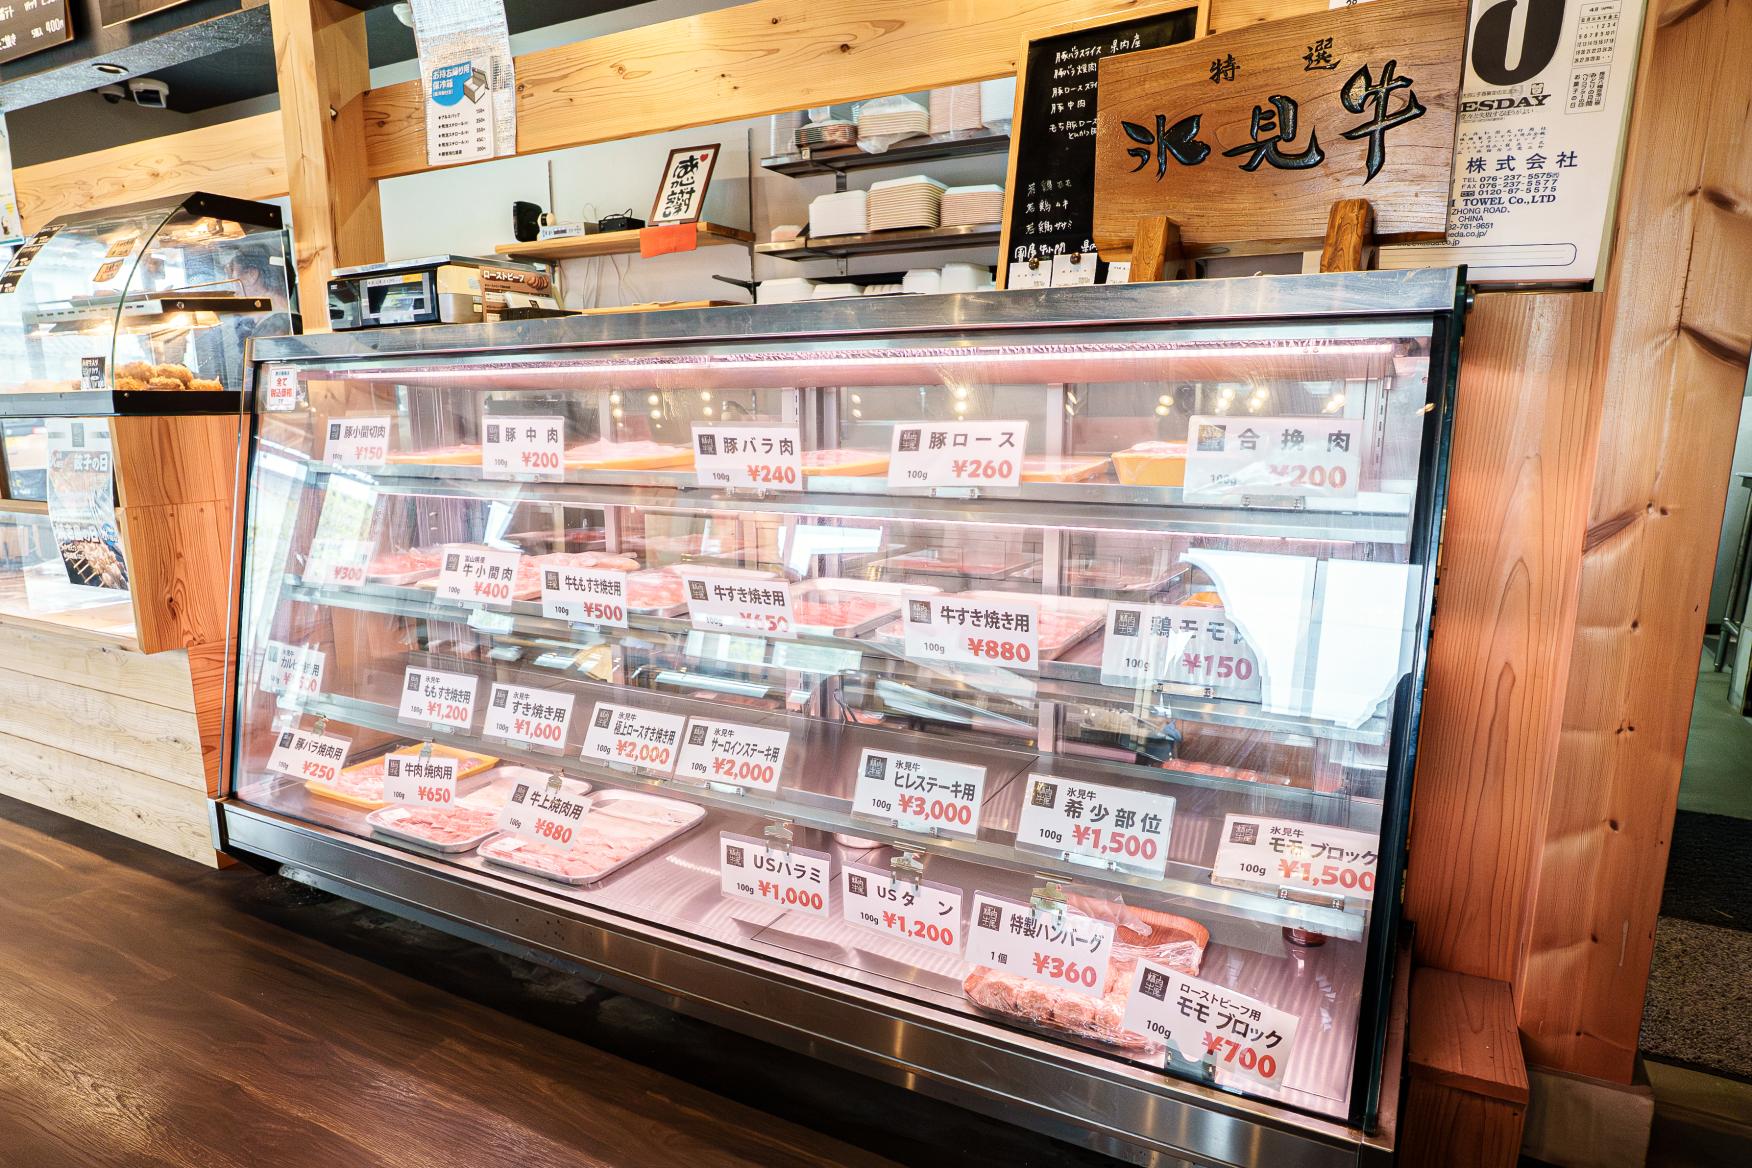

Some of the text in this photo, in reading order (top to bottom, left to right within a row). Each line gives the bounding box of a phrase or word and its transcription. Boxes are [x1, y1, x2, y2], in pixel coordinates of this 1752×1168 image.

[1110, 33, 1141, 54] 県内産
[1209, 36, 1341, 84] 特選
[1461, 94, 1551, 112] ESDAY
[1121, 59, 1427, 186] 氷見牛
[1466, 151, 1578, 174] 株式会社
[1478, 186, 1556, 196] 0120-87-5575
[1479, 179, 1557, 189] 076-237-5577
[1463, 197, 1505, 207] TOWEL
[1458, 215, 1484, 223] CHINA
[483, 270, 525, 283] ローストビーフ
[343, 425, 386, 439] 豚小間切肉
[505, 427, 558, 443] 豚中肉
[929, 432, 1015, 450] 豚ロース
[354, 446, 383, 460] ¥150
[723, 436, 794, 456] 豚バラ肉
[522, 451, 559, 468] ¥200
[907, 459, 1013, 480] 100g ¥260
[712, 464, 796, 484] 100g ¥240
[463, 563, 513, 581] 牛小間肉
[473, 581, 509, 599] ¥400
[714, 584, 785, 607] 牛すき焼き用
[554, 601, 623, 621] 100g ¥500
[940, 605, 1030, 633] 牛すき焼き用
[924, 637, 1031, 663] 100g ¥880
[1182, 653, 1252, 681] ¥150
[427, 700, 468, 721] ¥1,200
[512, 700, 566, 723] すき焼き用
[617, 711, 637, 721] 氷見牛
[496, 718, 561, 742] 100g ¥1,600
[713, 728, 735, 738] 氷見牛
[294, 737, 344, 761] 豚バラ焼肉用
[596, 739, 670, 765] 100g ¥2,000
[711, 737, 780, 763] サーロインステーキ用
[303, 760, 335, 781] ¥250
[404, 762, 453, 780] 牛肉焼肉用
[691, 756, 774, 783] 100g ¥2,000
[895, 759, 920, 772] 氷見牛
[418, 785, 451, 803] ¥650
[894, 771, 976, 802] ヒレステーキ用
[1066, 787, 1097, 801] 氷見牛
[530, 790, 584, 820] 牛上焼肉用
[872, 793, 972, 825] 100g ¥3,000
[1064, 798, 1162, 835] 希少部位
[534, 817, 572, 844] ¥880
[1269, 826, 1304, 838] 氷見牛
[1039, 824, 1157, 860] 100g ¥1,500
[754, 854, 821, 884] USハラミ
[1239, 858, 1375, 892] 100g ¥1,500
[737, 879, 823, 910] 100g ¥1,000
[860, 911, 879, 926] 100g
[883, 910, 953, 946] ¥1,200
[1010, 913, 1105, 954] 特製ハンバーグ
[1032, 952, 1097, 988] ¥360
[1180, 983, 1262, 1022] ローストビーフ用
[1146, 1019, 1277, 1079] 100g ¥700
